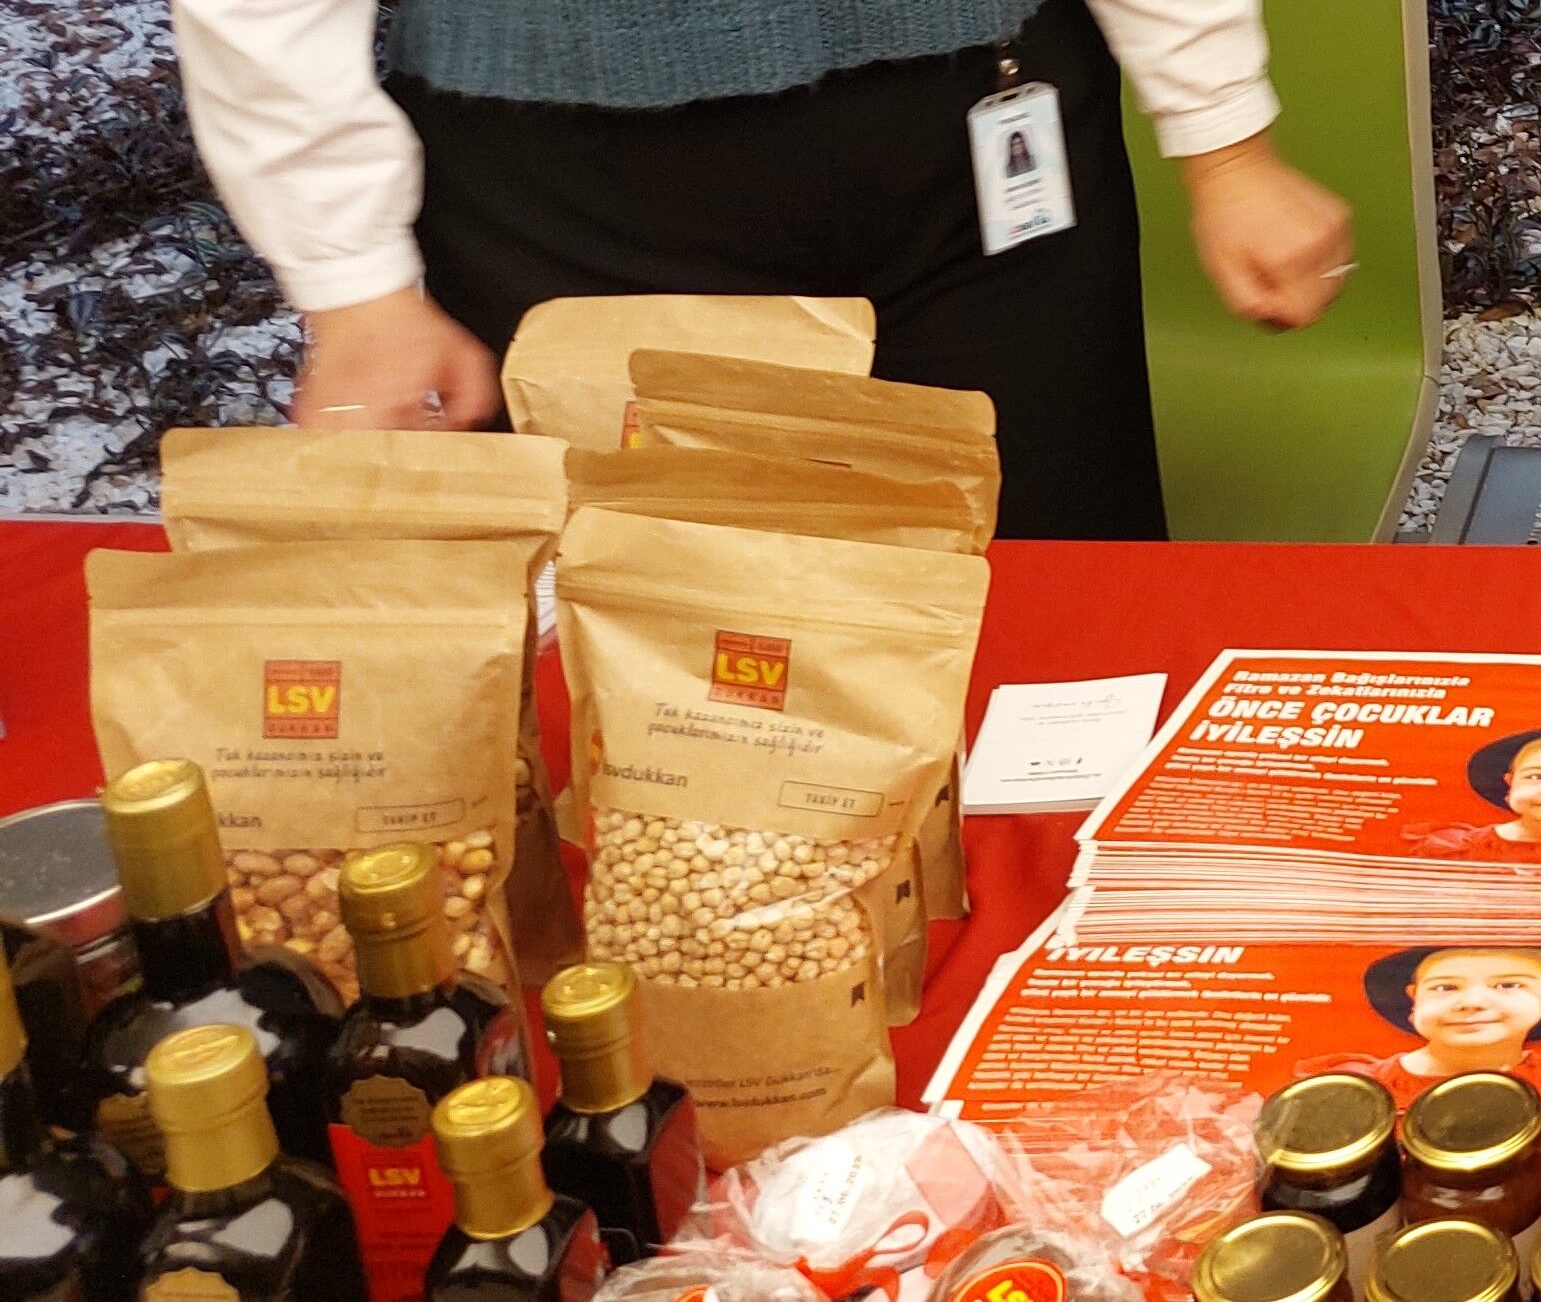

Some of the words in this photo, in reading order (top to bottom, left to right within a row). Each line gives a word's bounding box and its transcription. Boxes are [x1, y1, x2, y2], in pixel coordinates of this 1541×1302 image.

[716, 654, 784, 685] LSV
[1233, 670, 1326, 684] Ramazan
[267, 685, 336, 715] LSV
[1278, 685, 1302, 696] ve
[1208, 696, 1306, 720] ÖNCE
[1311, 701, 1496, 728] ÇOCUKLAR
[1188, 719, 1365, 750] İYİLEŞSİN
[367, 1168, 422, 1187] LSV
